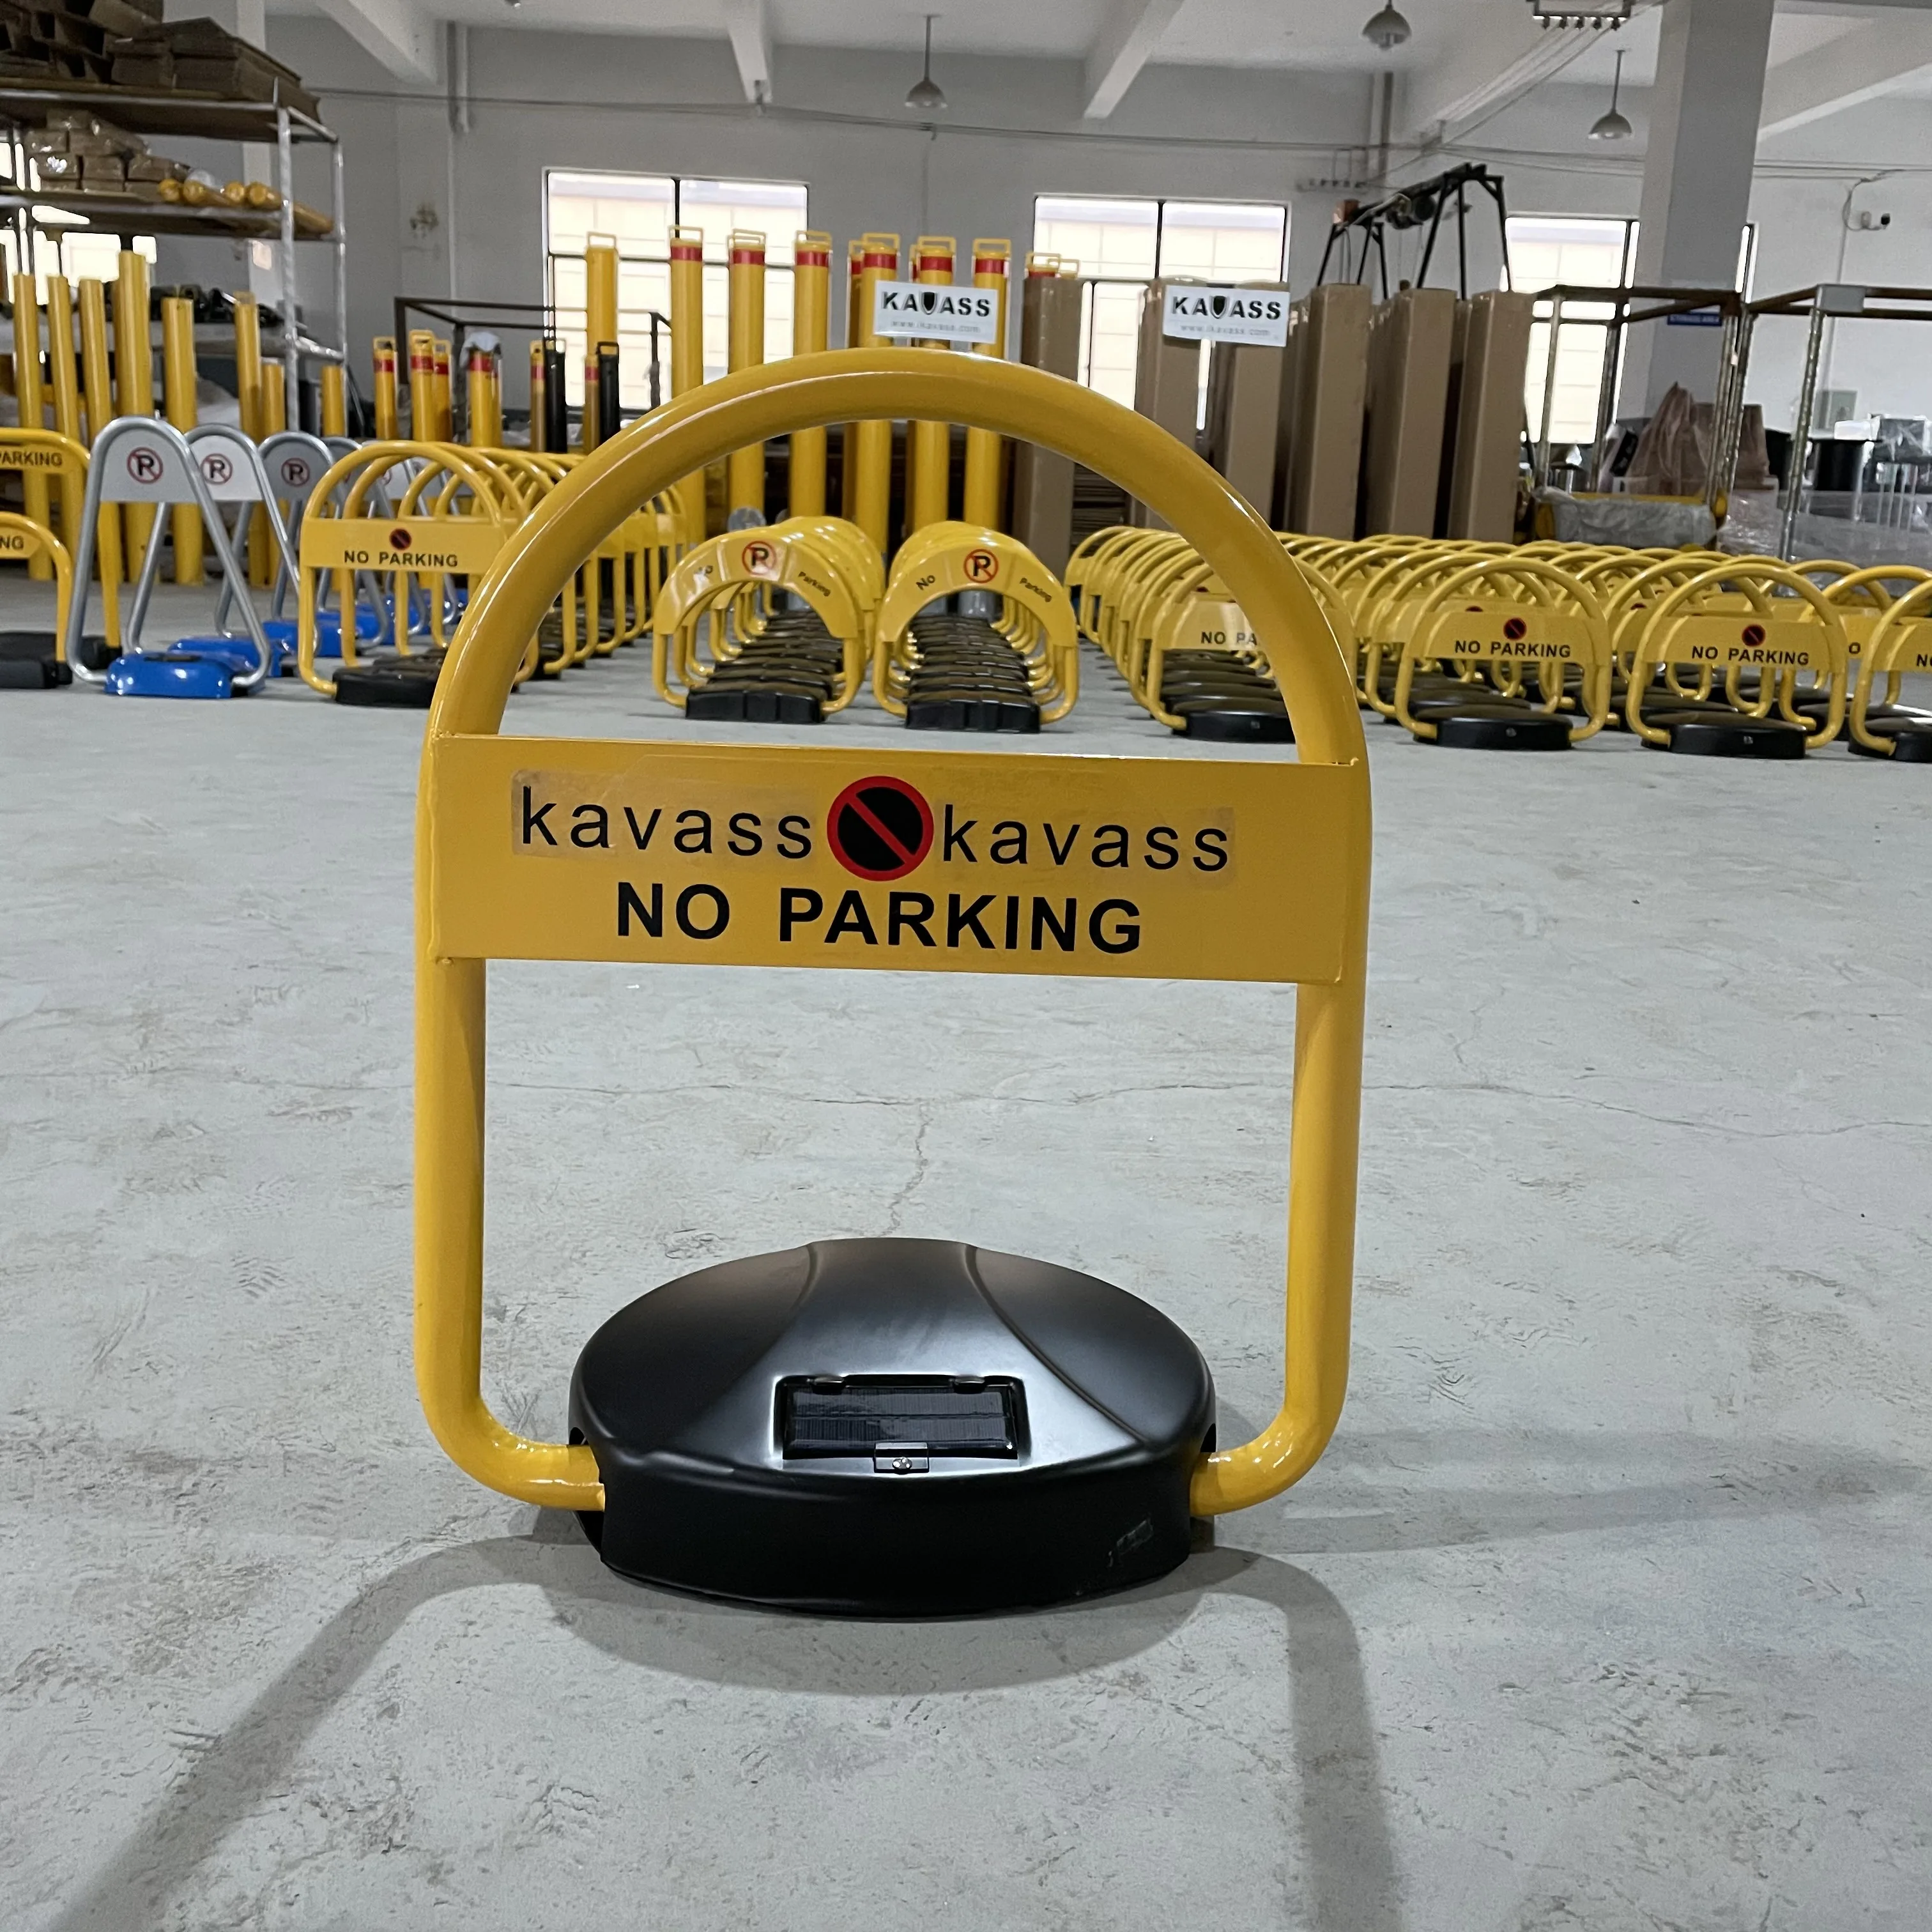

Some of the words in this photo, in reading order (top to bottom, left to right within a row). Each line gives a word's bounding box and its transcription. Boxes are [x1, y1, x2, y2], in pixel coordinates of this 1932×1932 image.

[882, 291, 991, 318] KAVASS
[1172, 295, 1282, 320] KAVASS
[0, 451, 63, 467] ARKING
[344, 550, 369, 564] NO
[379, 551, 458, 567] PARKING
[916, 574, 936, 590] No
[1200, 631, 1227, 645] NO
[1455, 640, 1480, 654] NO
[1491, 641, 1571, 658] PARKING
[1692, 646, 1719, 660] NO
[1728, 648, 1809, 666] PARKING
[523, 786, 811, 859] kavass
[943, 804, 1228, 871] kavass
[618, 882, 730, 940] NO
[779, 887, 1140, 954] PARKING
